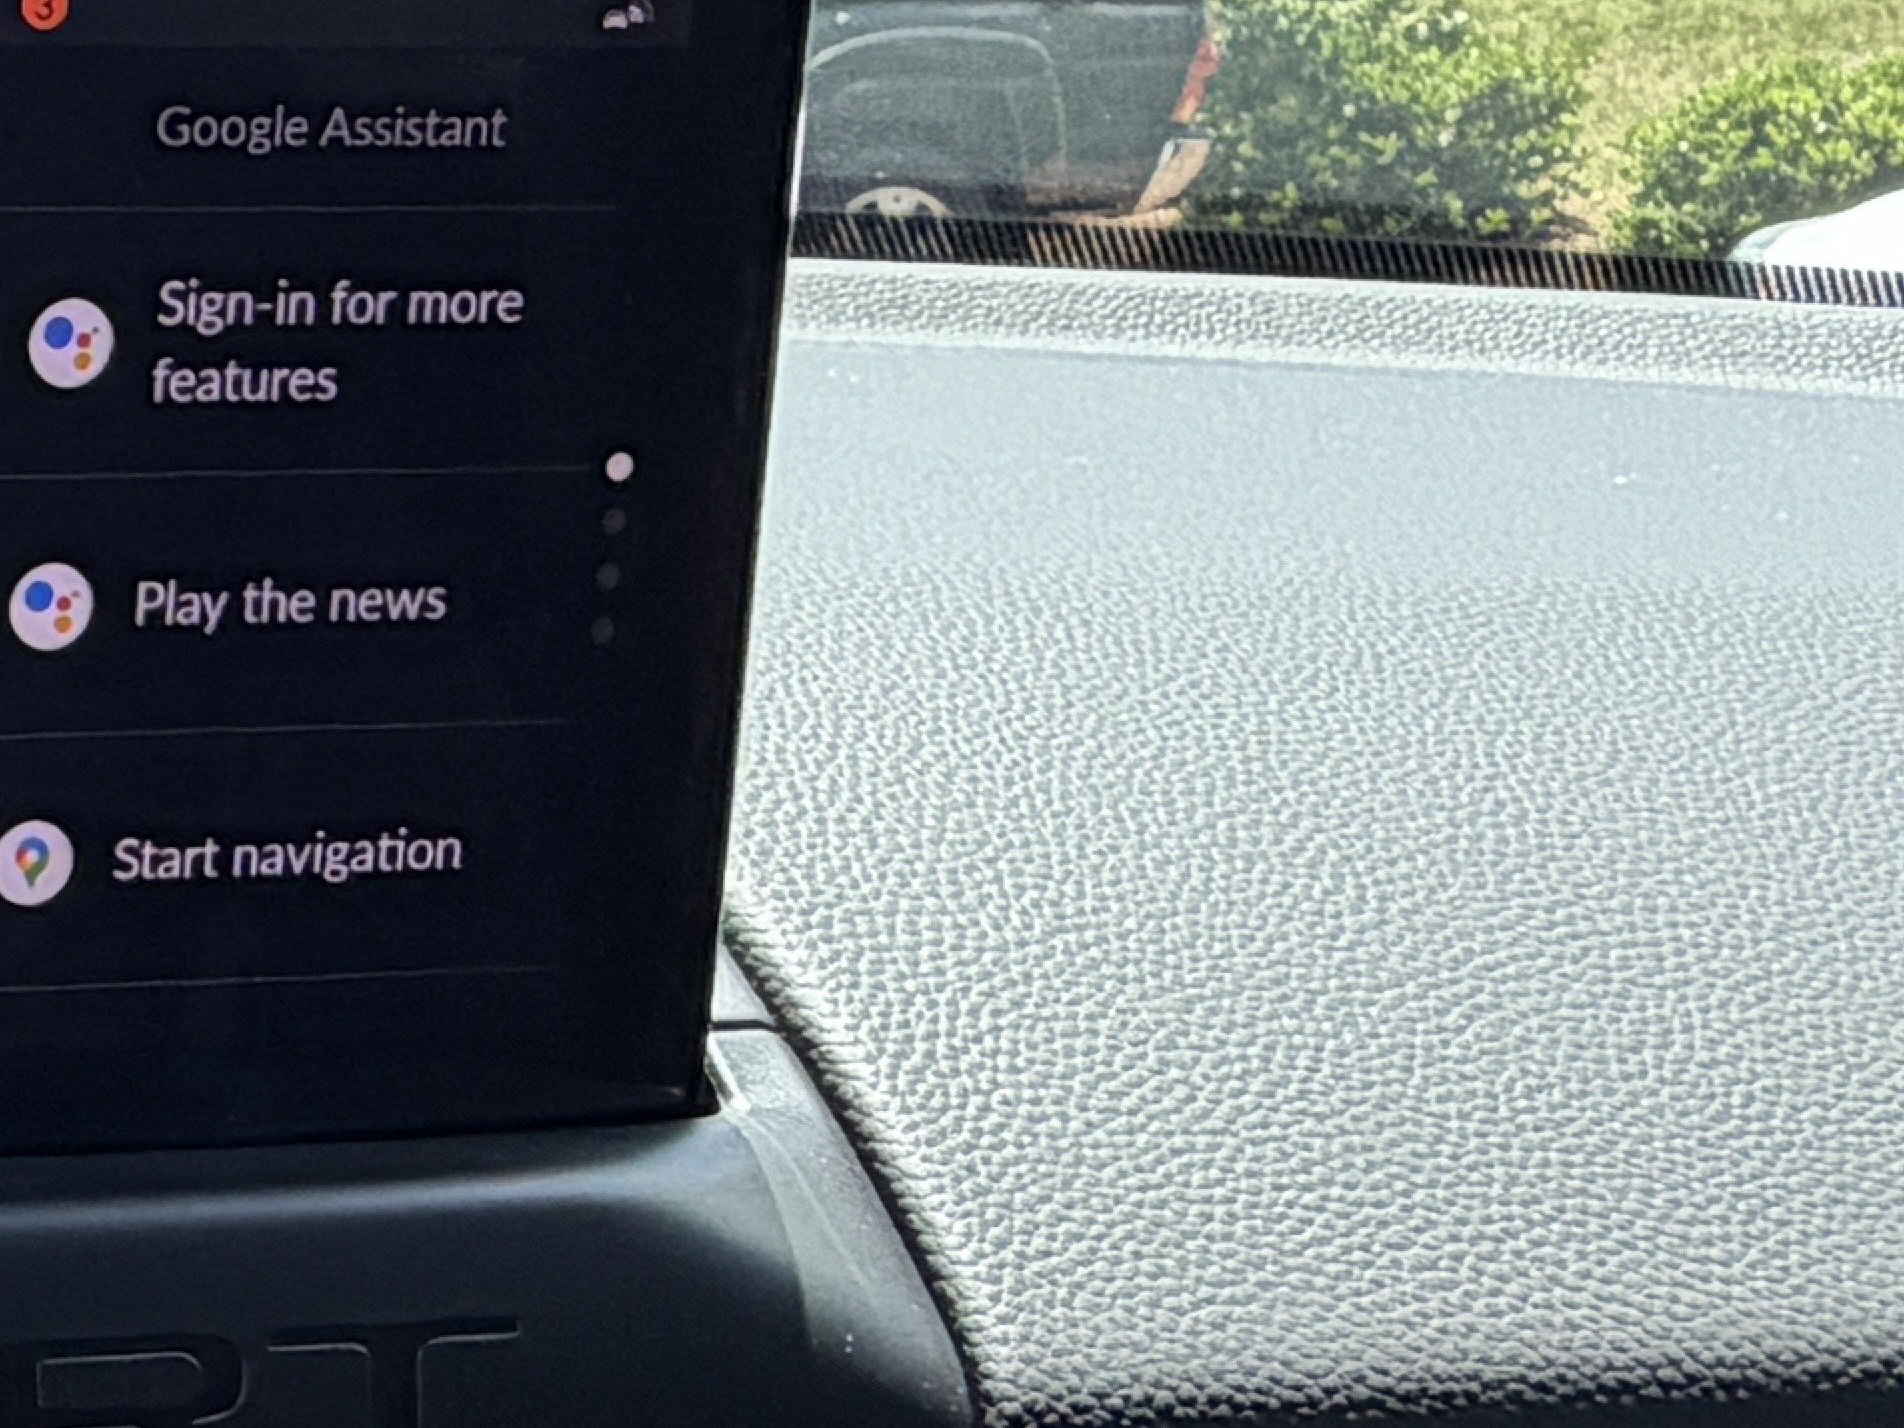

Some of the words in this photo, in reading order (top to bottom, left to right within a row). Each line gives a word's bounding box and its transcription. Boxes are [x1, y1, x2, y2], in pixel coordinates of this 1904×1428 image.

[156, 104, 310, 155] Google
[318, 106, 508, 148] Assistant
[157, 278, 316, 336] Sign-in
[330, 278, 398, 325] for
[408, 290, 524, 324] more
[152, 356, 338, 404] features
[134, 578, 229, 635] Play
[242, 576, 316, 624] the
[328, 586, 446, 622] news
[112, 837, 220, 882] Start
[232, 826, 462, 884] navigation
